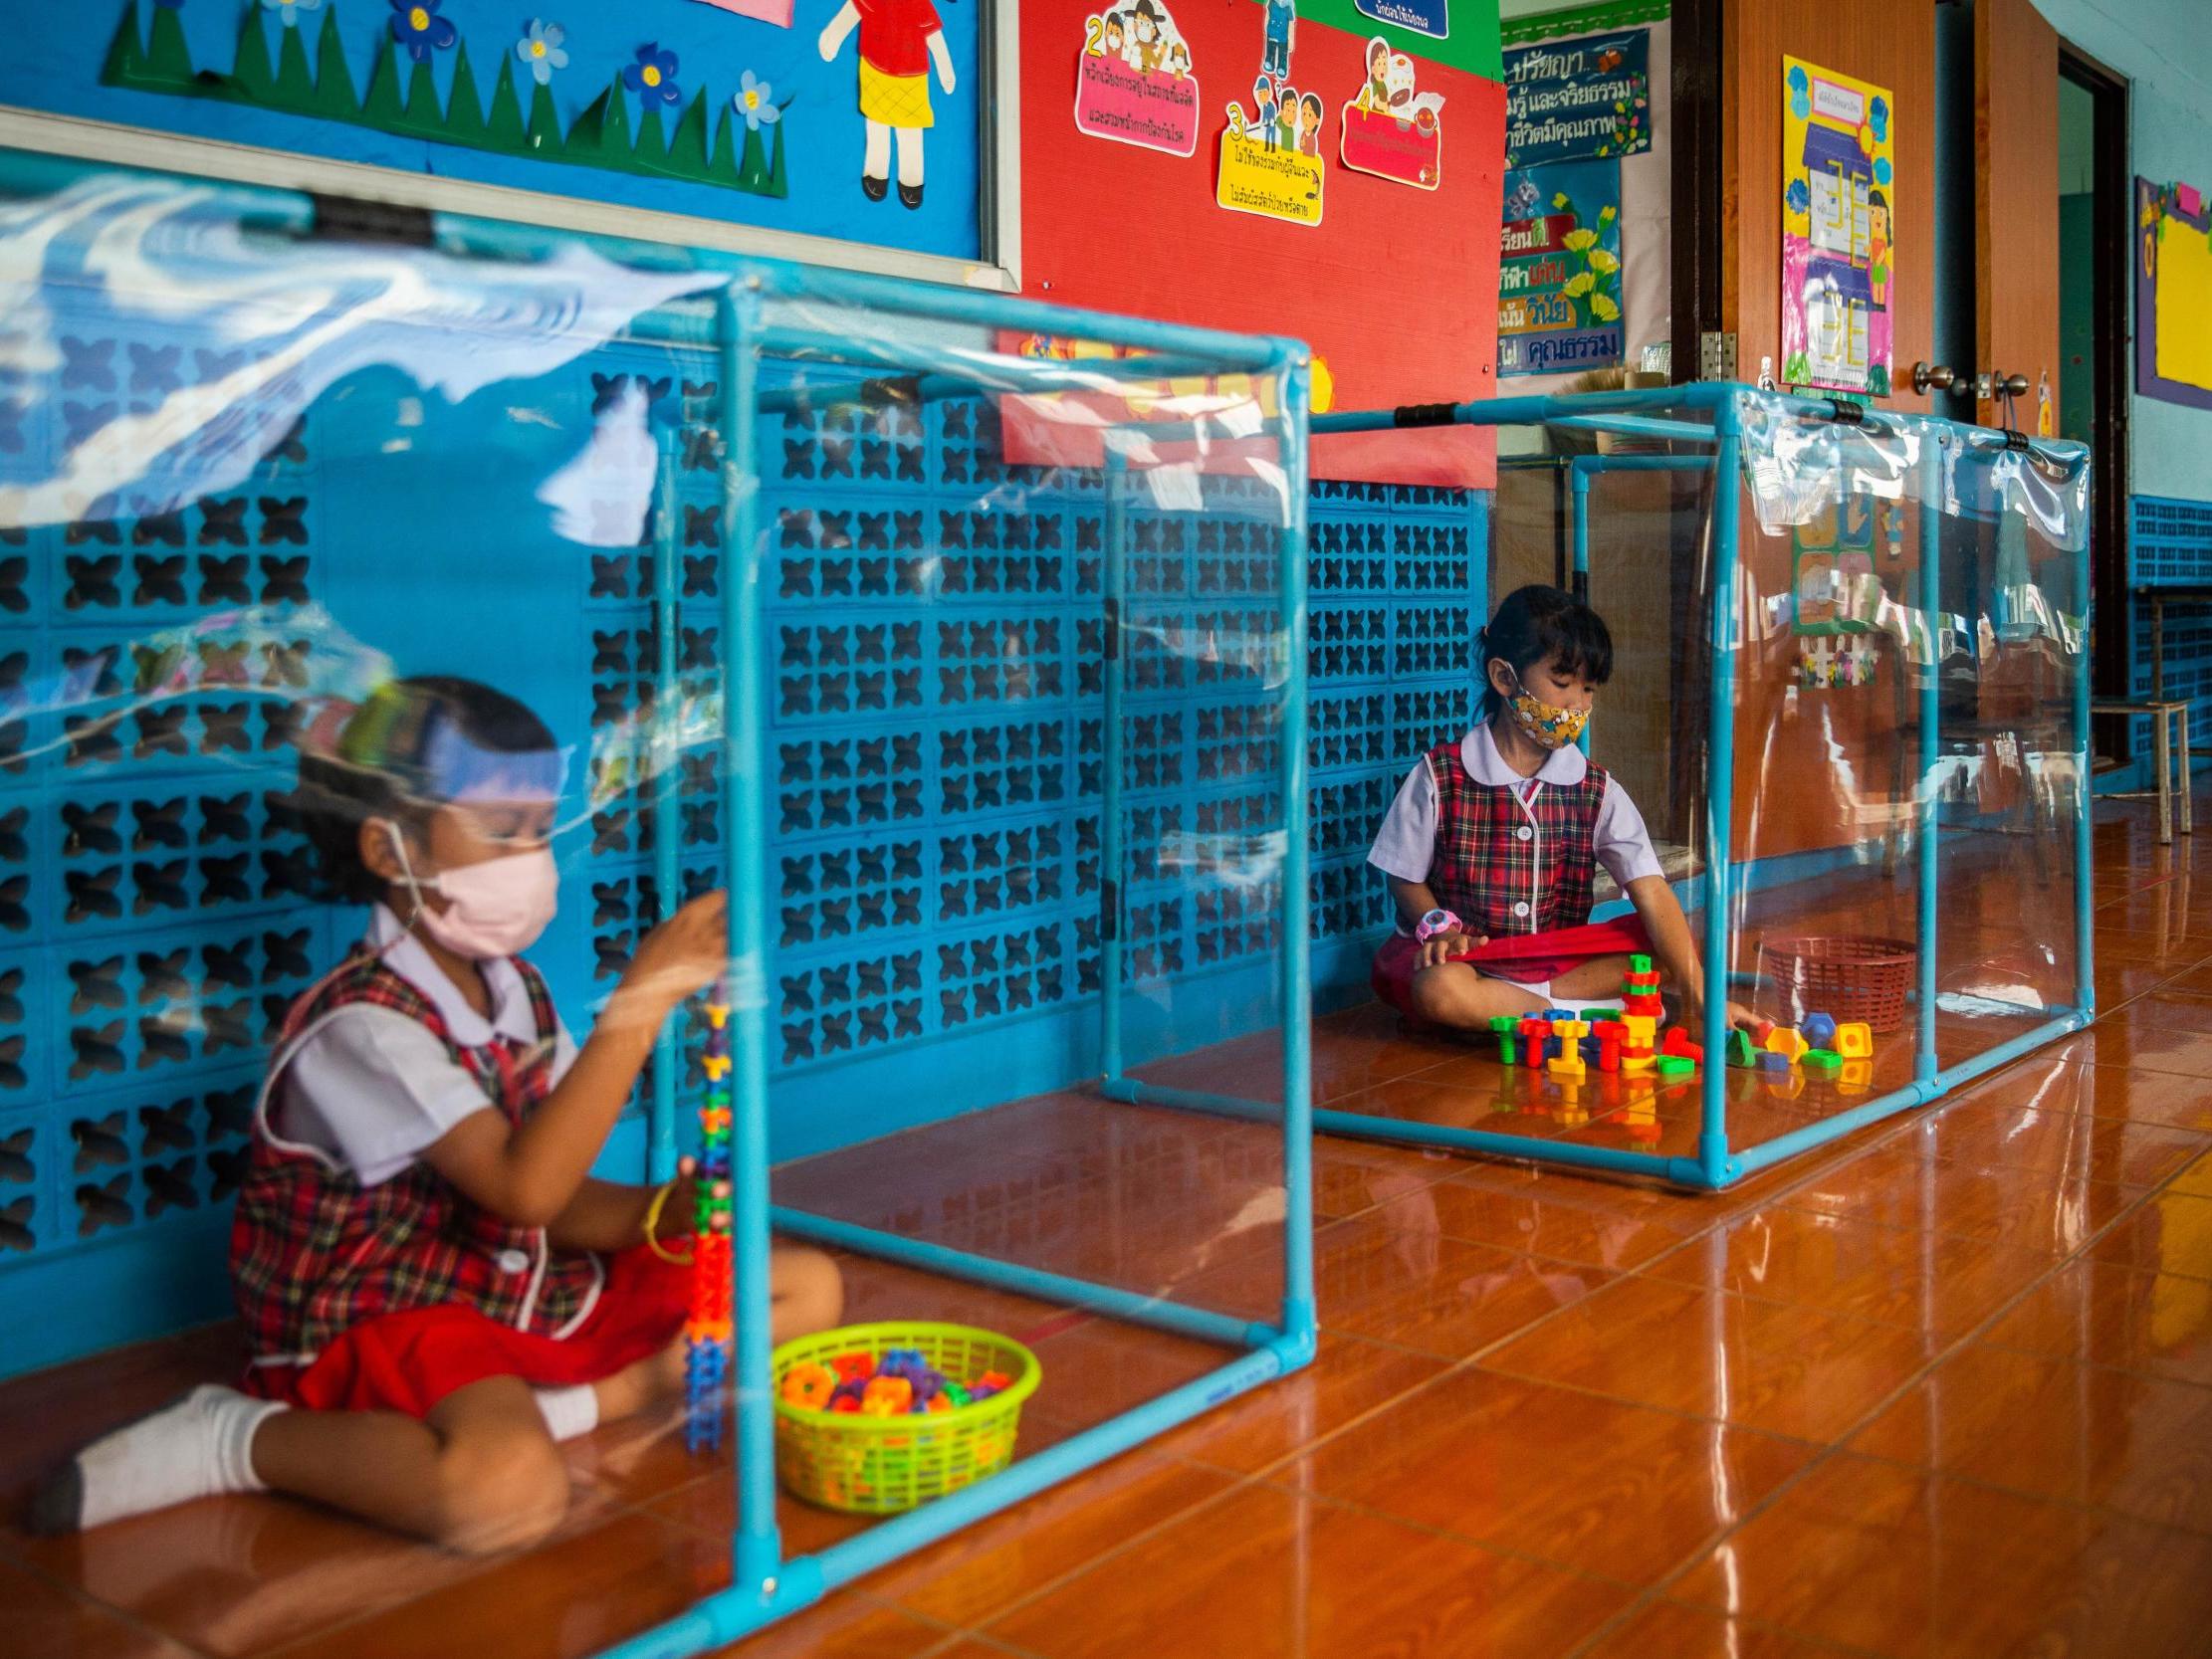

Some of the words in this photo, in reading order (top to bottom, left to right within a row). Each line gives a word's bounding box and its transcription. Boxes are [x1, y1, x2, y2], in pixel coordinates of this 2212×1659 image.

[1087, 17, 1103, 58] 2
[1228, 104, 1243, 141] 3
[1356, 87, 1371, 121] 4
